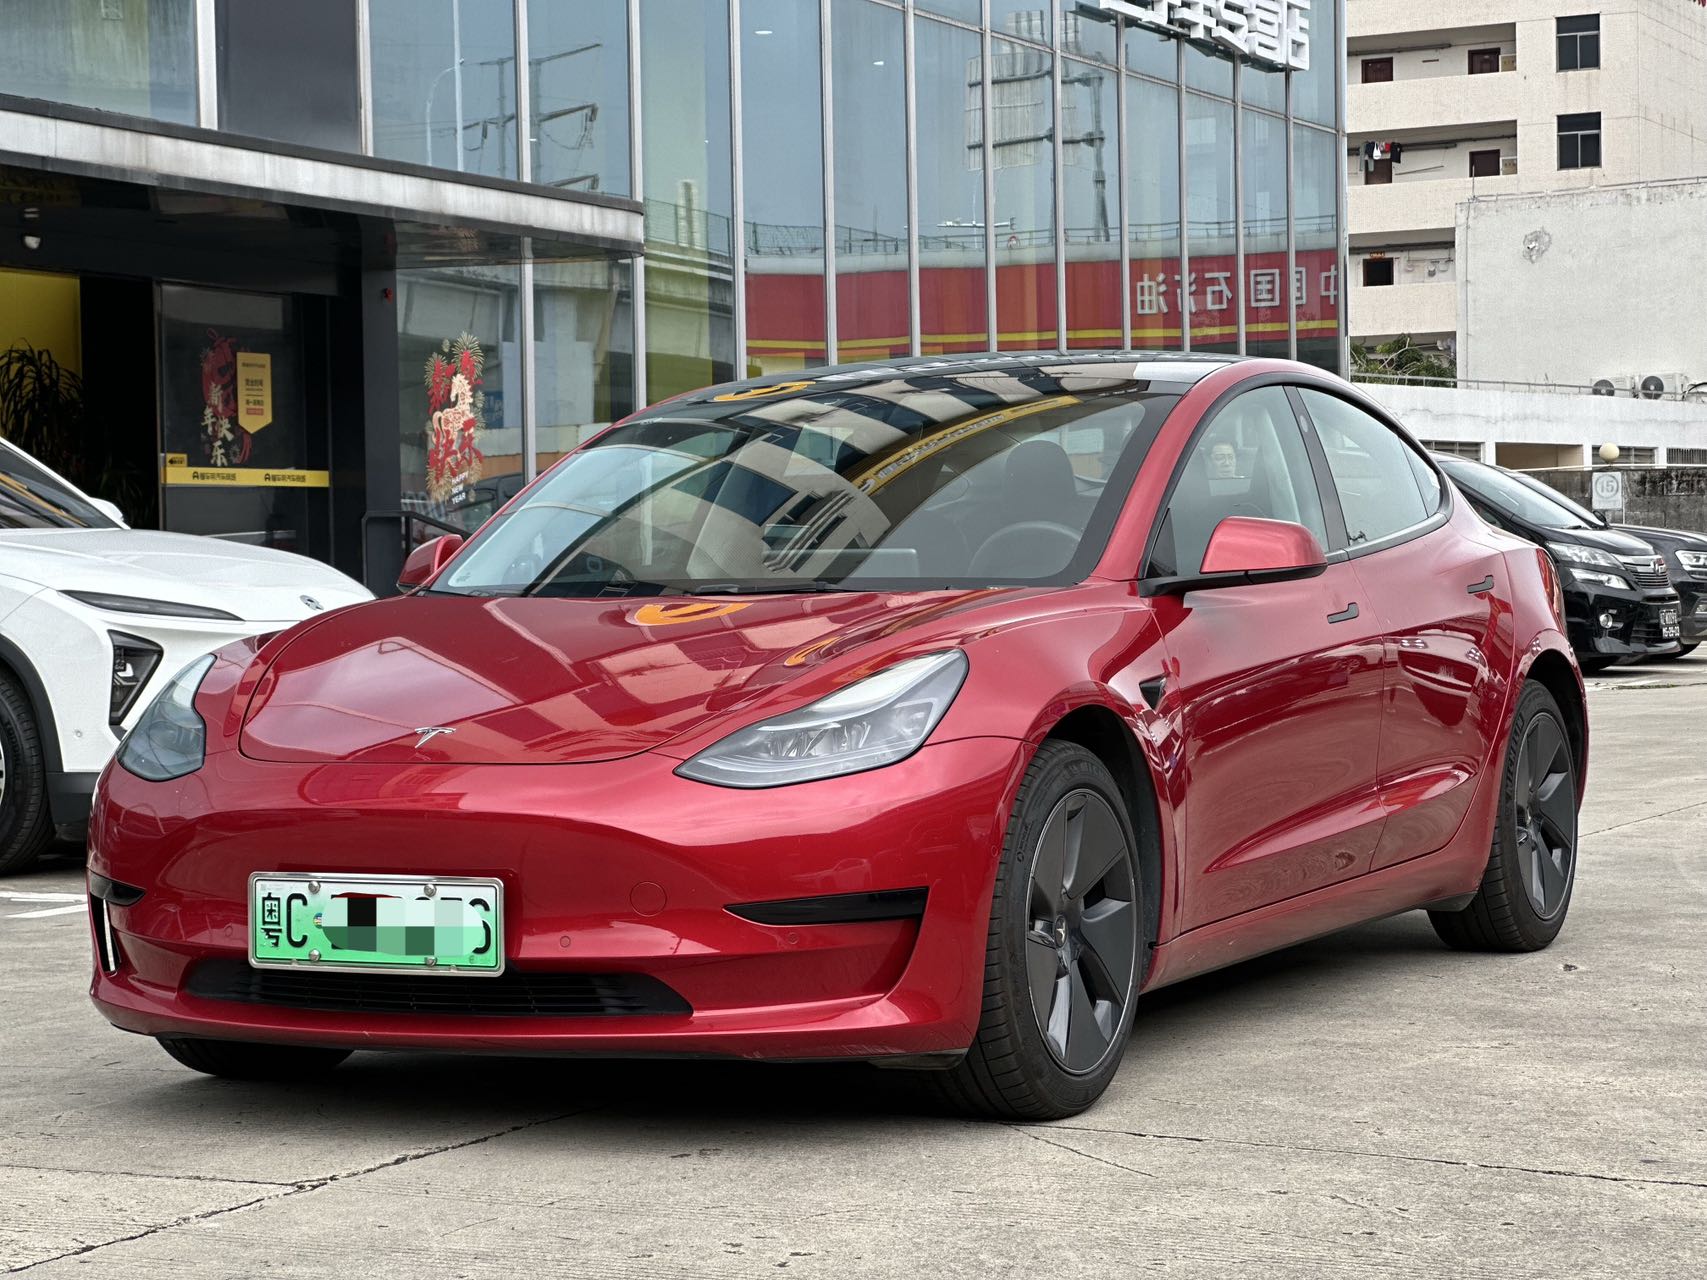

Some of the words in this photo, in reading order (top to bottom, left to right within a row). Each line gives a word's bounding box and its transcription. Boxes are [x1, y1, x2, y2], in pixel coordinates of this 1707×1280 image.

[451, 471, 469, 486] HAPPY
[452, 483, 464, 495] NEW
[1598, 480, 1614, 493] 15
[452, 492, 467, 505] YEAR
